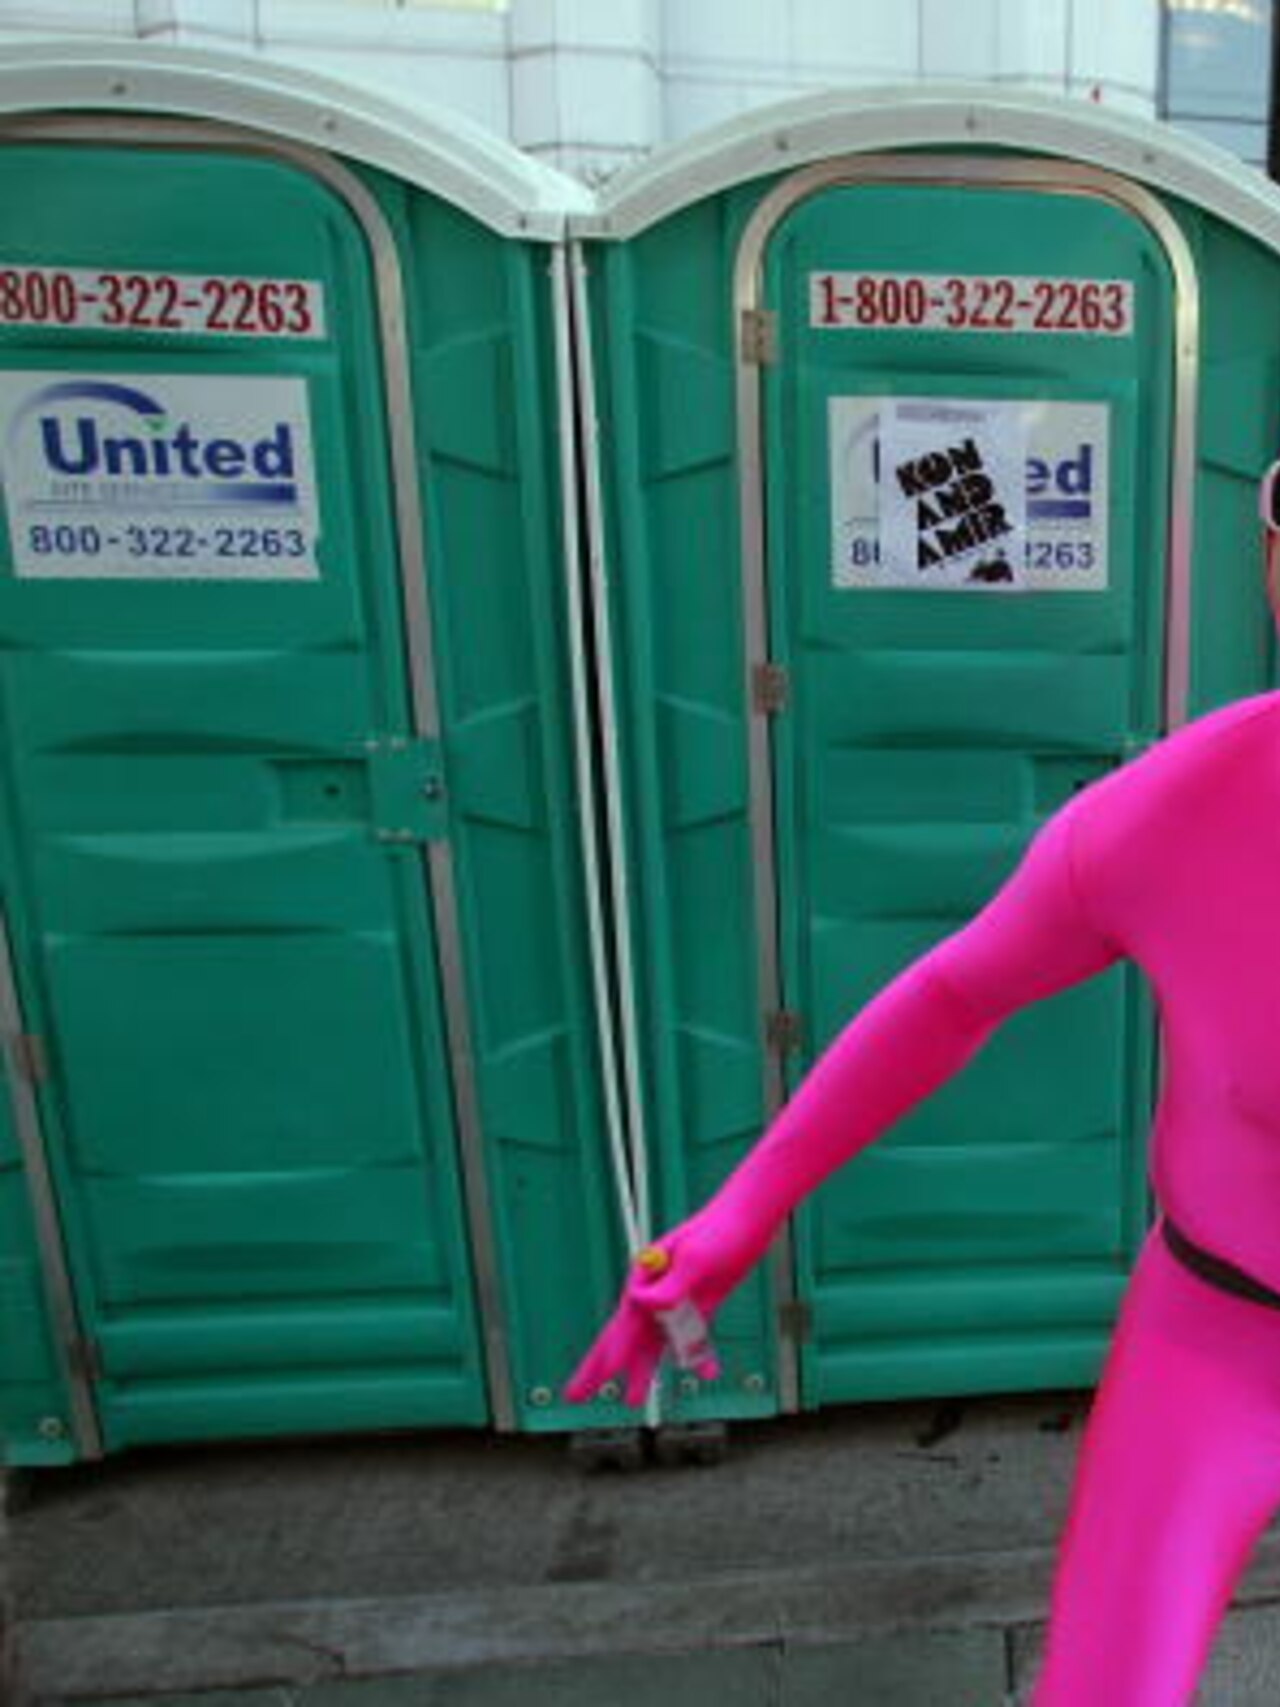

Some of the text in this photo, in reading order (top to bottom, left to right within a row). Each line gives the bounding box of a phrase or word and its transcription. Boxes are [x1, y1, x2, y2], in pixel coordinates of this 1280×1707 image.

[0, 271, 311, 333] 800-322-2263
[819, 275, 1126, 331] 1-800-322-2263
[40, 416, 295, 479] United
[30, 525, 306, 557] 800-322-2263
